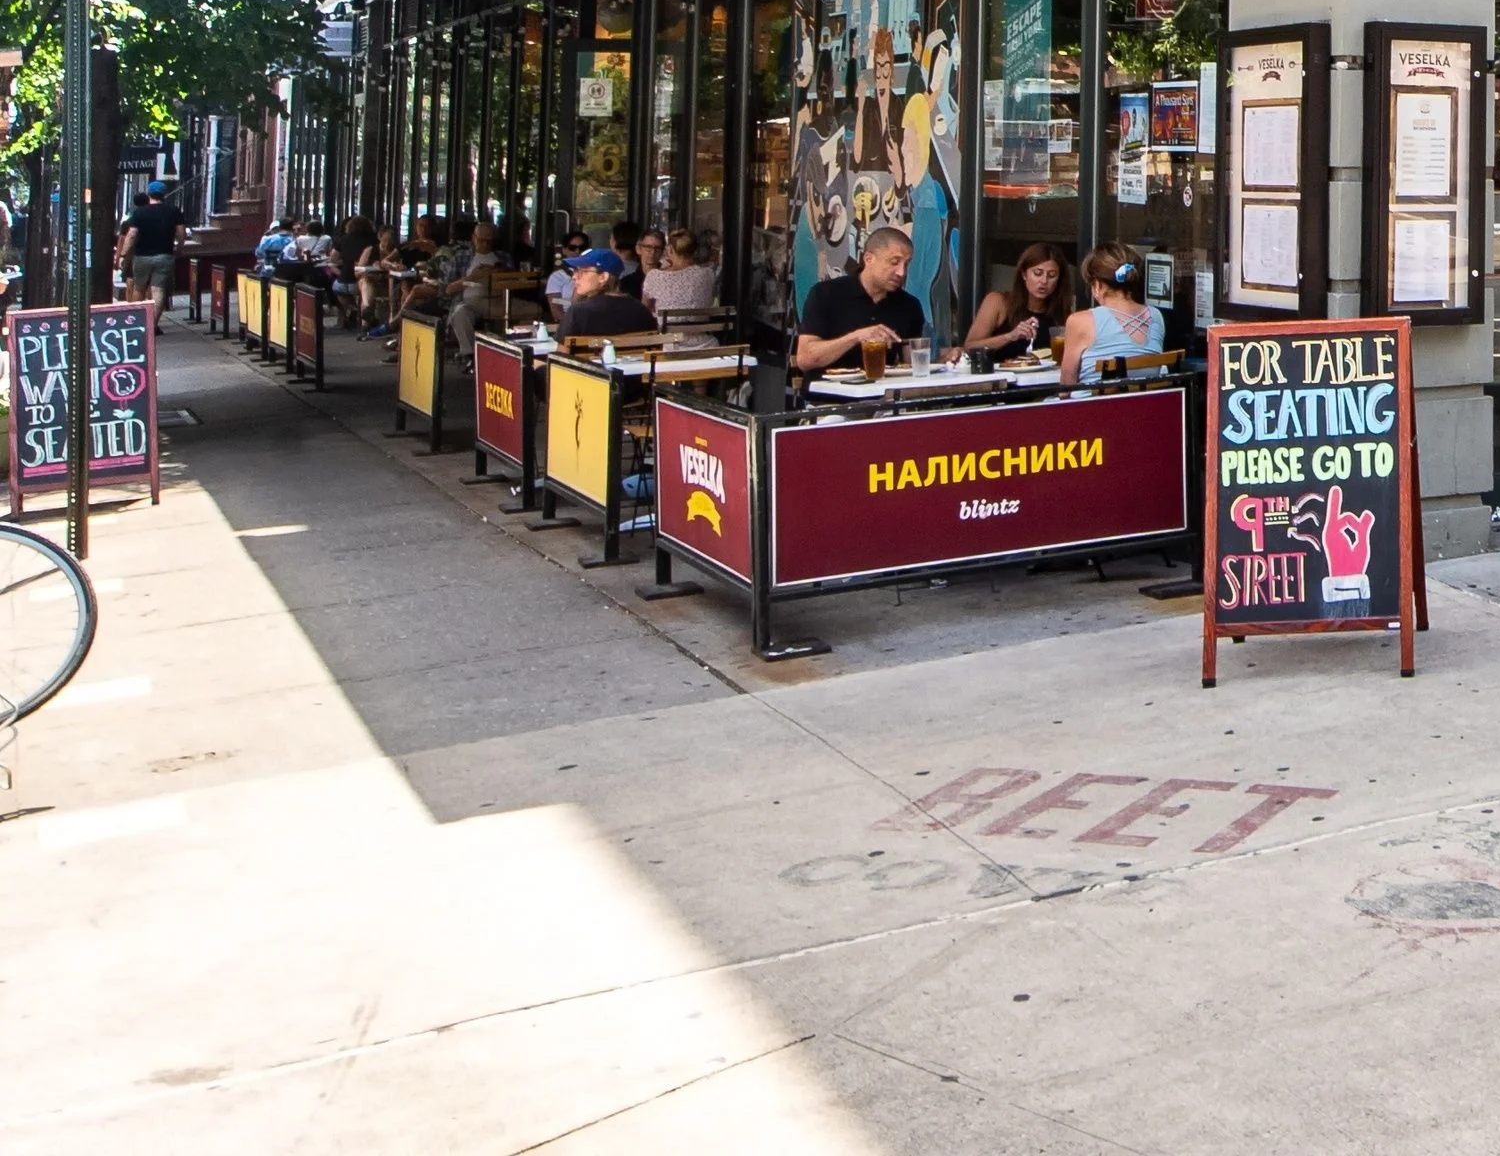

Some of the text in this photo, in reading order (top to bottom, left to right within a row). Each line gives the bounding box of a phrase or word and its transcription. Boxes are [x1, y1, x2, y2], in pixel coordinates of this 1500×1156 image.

[1007, 0, 1042, 42] ESCAPE
[1258, 57, 1285, 71] VESELKA
[1399, 52, 1451, 69] VESELKA
[18, 327, 146, 373] PLASE
[1220, 335, 1395, 391] FOR TABLE
[19, 367, 107, 406] WAT
[25, 404, 55, 426] TO
[1222, 382, 1396, 445] SEATING
[20, 418, 147, 468] SETED
[869, 437, 1104, 494] НАЛИСНИКИ
[1221, 442, 1395, 487] PLEASE GO TO
[679, 443, 726, 505] VESELKA
[959, 498, 1020, 520] blintz
[1229, 493, 1290, 552] 9TH
[1219, 551, 1308, 610] STREET
[867, 767, 1340, 854] BEET
